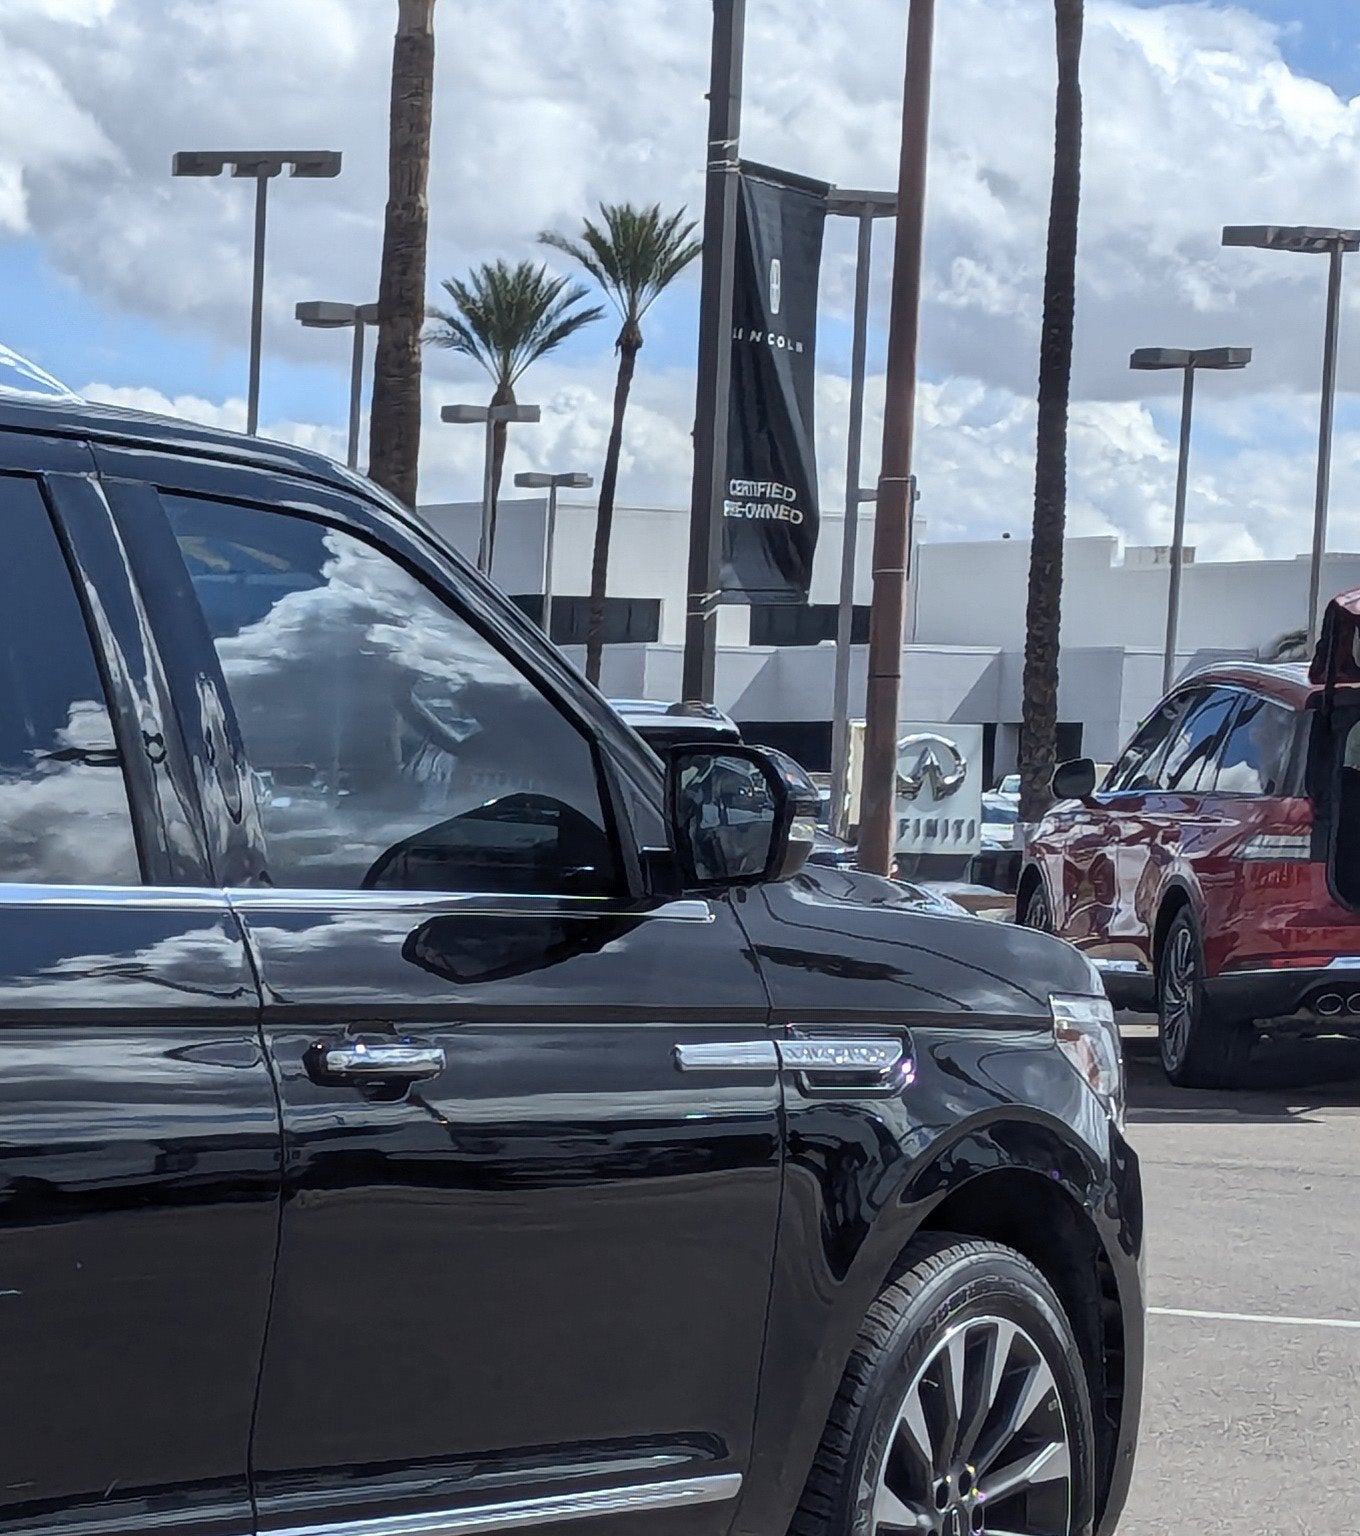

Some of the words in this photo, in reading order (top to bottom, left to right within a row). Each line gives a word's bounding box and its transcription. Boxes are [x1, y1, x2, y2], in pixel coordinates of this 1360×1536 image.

[732, 327, 804, 354] LINCOLN
[729, 479, 797, 502] CERTIFIED
[898, 818, 976, 842] FINITI
